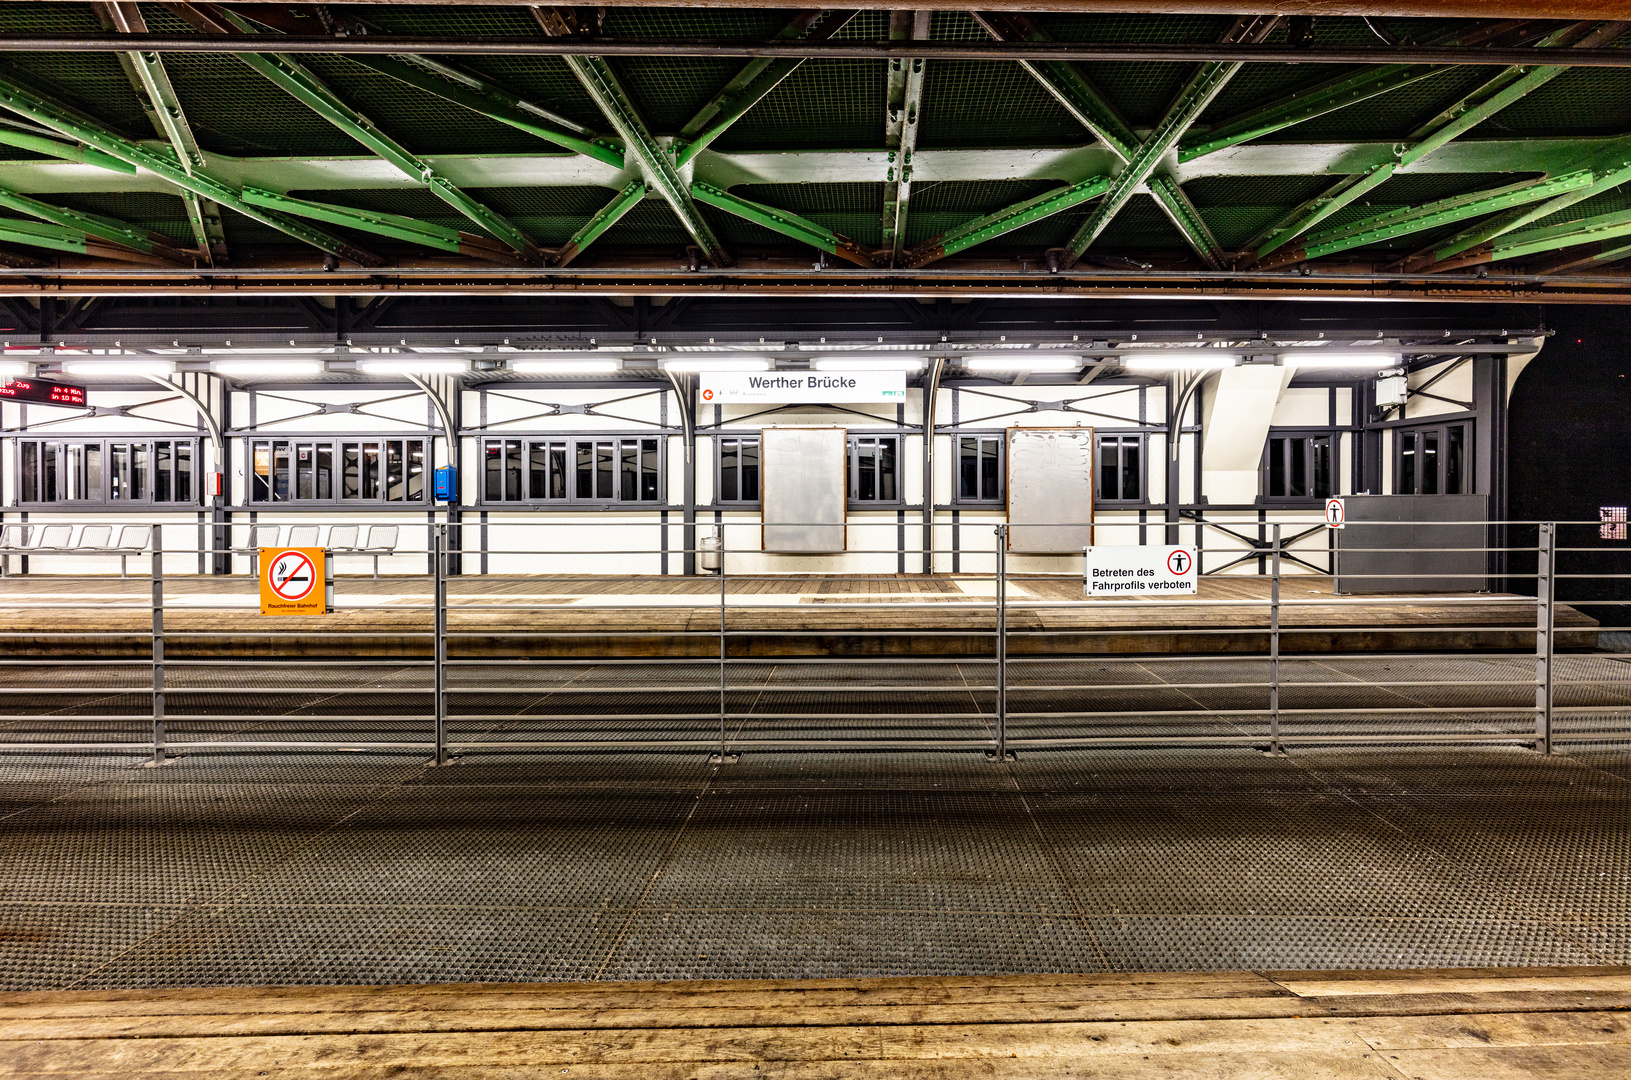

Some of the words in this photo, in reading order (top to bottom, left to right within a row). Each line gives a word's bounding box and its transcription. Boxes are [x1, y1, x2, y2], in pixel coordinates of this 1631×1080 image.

[16, 381, 31, 389] Zug
[749, 376, 804, 389] Werther
[807, 376, 856, 389] Brücke
[1092, 568, 1134, 577] Betreten
[1136, 568, 1155, 577] des
[1092, 581, 1146, 592] Fahrprofils
[1148, 580, 1191, 590] verboten
